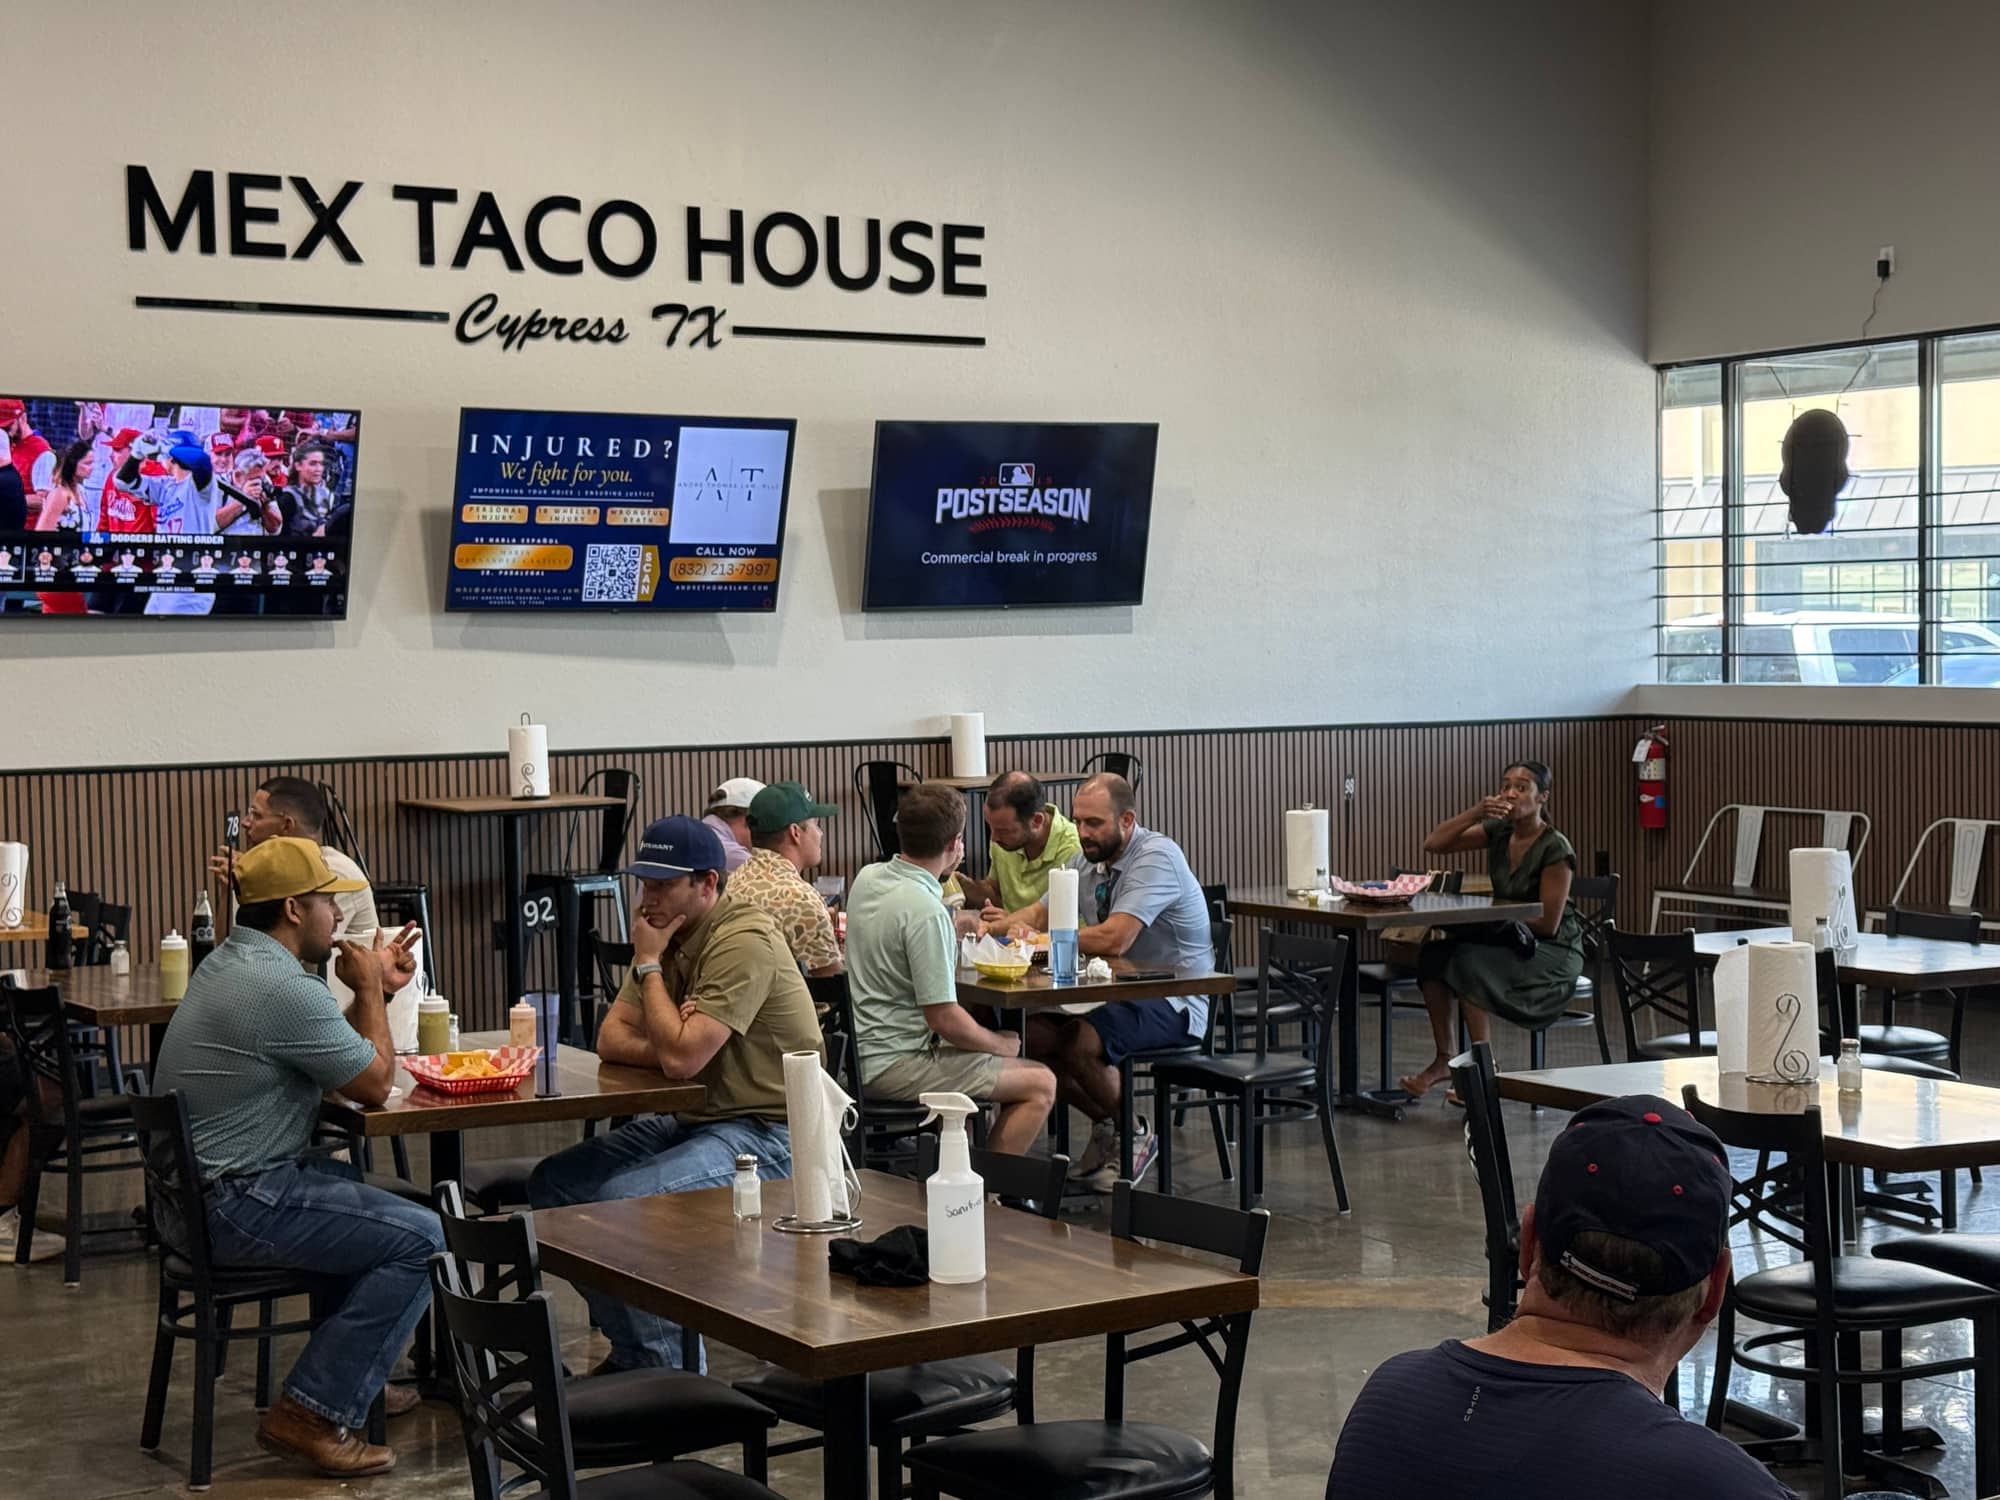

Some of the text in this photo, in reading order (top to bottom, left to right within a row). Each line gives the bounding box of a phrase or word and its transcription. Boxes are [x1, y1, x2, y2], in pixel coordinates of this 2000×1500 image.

[126, 164, 988, 298] MEX TACO HOUSE
[455, 293, 727, 351] Cypress TX
[469, 433, 673, 461] INJURED?
[501, 460, 633, 488] We fight for you.
[935, 488, 1092, 524] POSTSEASON
[110, 534, 225, 545] DODGERS BATTING ORDER
[695, 547, 757, 556] CALL NOW
[673, 563, 771, 577] (832) 213-7997
[921, 550, 1098, 565] Commercial break in progress
[640, 552, 653, 595] SCAN
[226, 815, 240, 837] 78
[523, 896, 555, 927] 92
